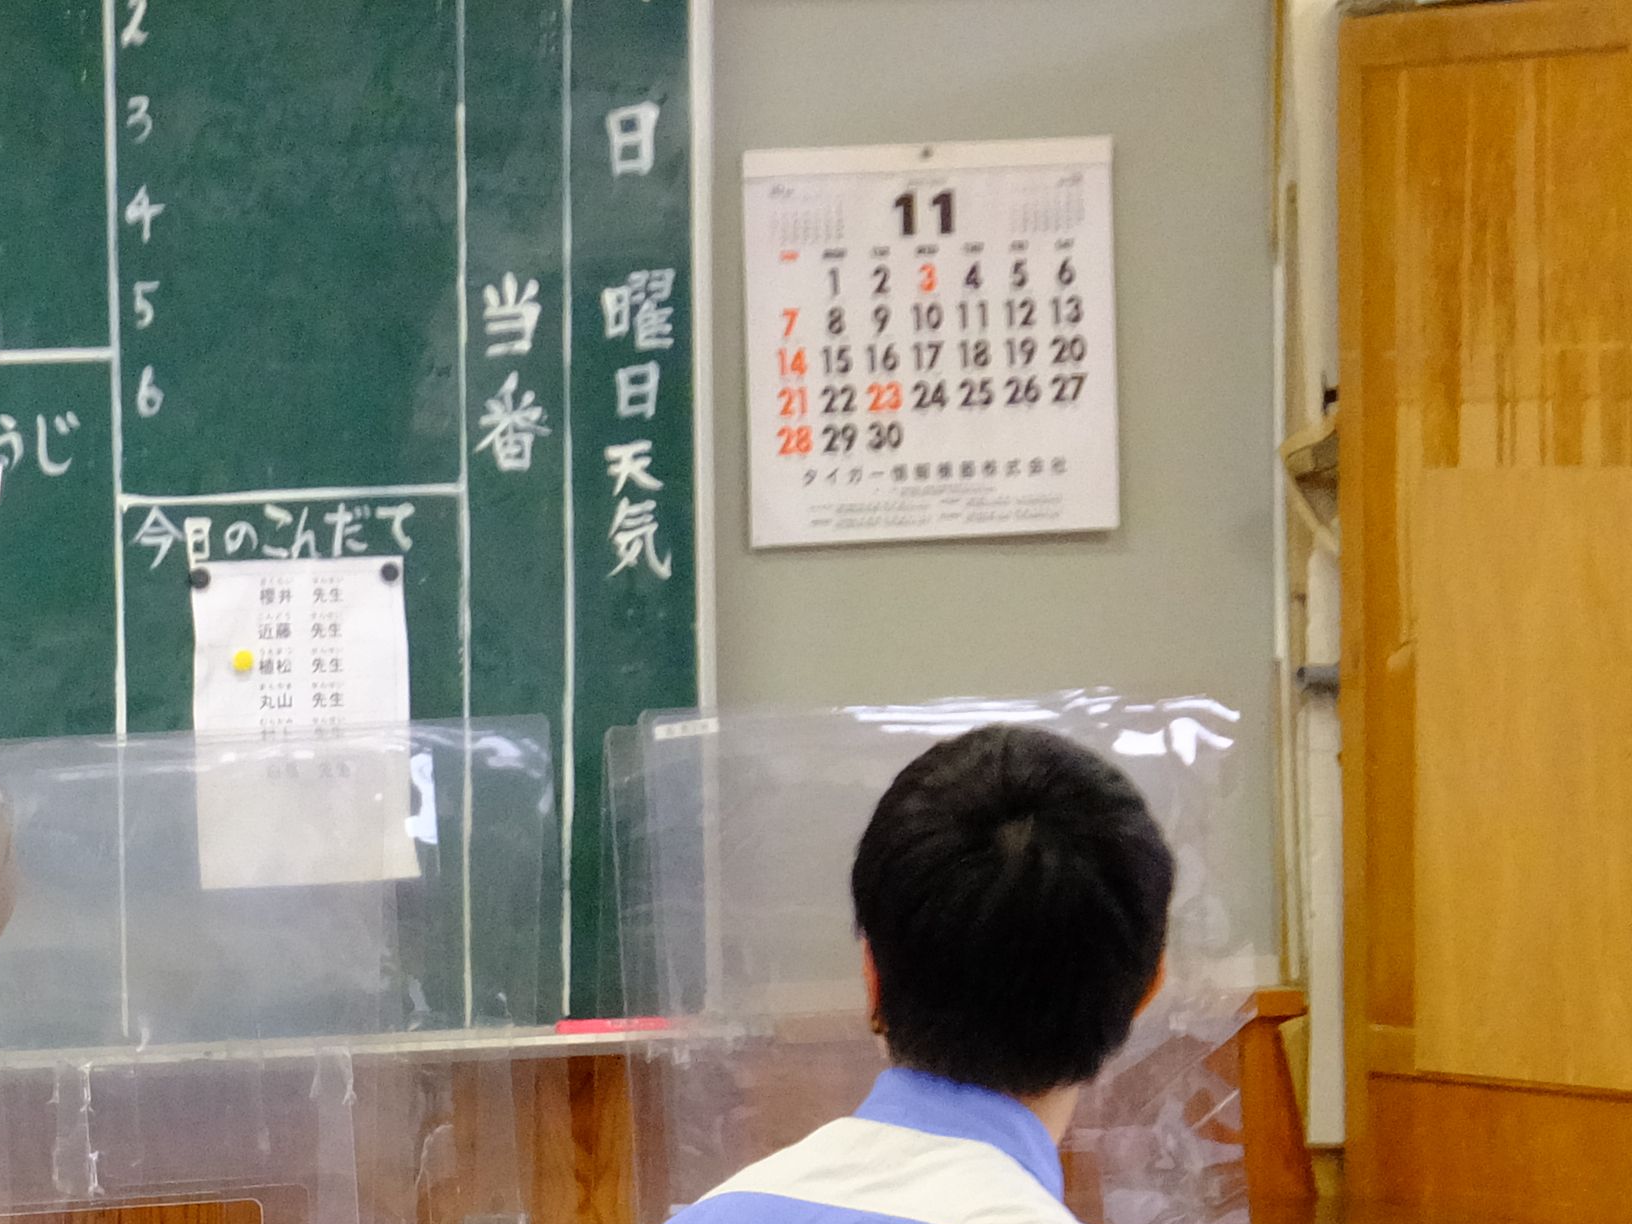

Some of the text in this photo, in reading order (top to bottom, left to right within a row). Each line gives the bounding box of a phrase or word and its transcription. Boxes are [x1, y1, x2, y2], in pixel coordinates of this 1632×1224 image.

[120, 0, 149, 48] 2
[126, 95, 153, 143] 3
[605, 100, 661, 176] 日
[125, 184, 166, 243] 4
[892, 188, 956, 237] 11
[828, 257, 1076, 297] 1 2 3 4 5 6
[133, 281, 161, 329] 5
[783, 296, 1084, 337] 7 8 9 10 11 12 13
[474, 271, 553, 472] 当番
[777, 335, 1087, 377] 14 15 16 17 18 19 20
[136, 365, 164, 417] 6
[777, 372, 1088, 418] 21 22 23 24 25 26 27
[777, 421, 904, 456] 28 29 30
[132, 502, 416, 571] 今日のこんだて
[312, 587, 344, 603] 先生
[258, 623, 344, 640] 近藤 先生
[312, 658, 344, 674] 先生
[259, 693, 344, 710] 丸山 先生
